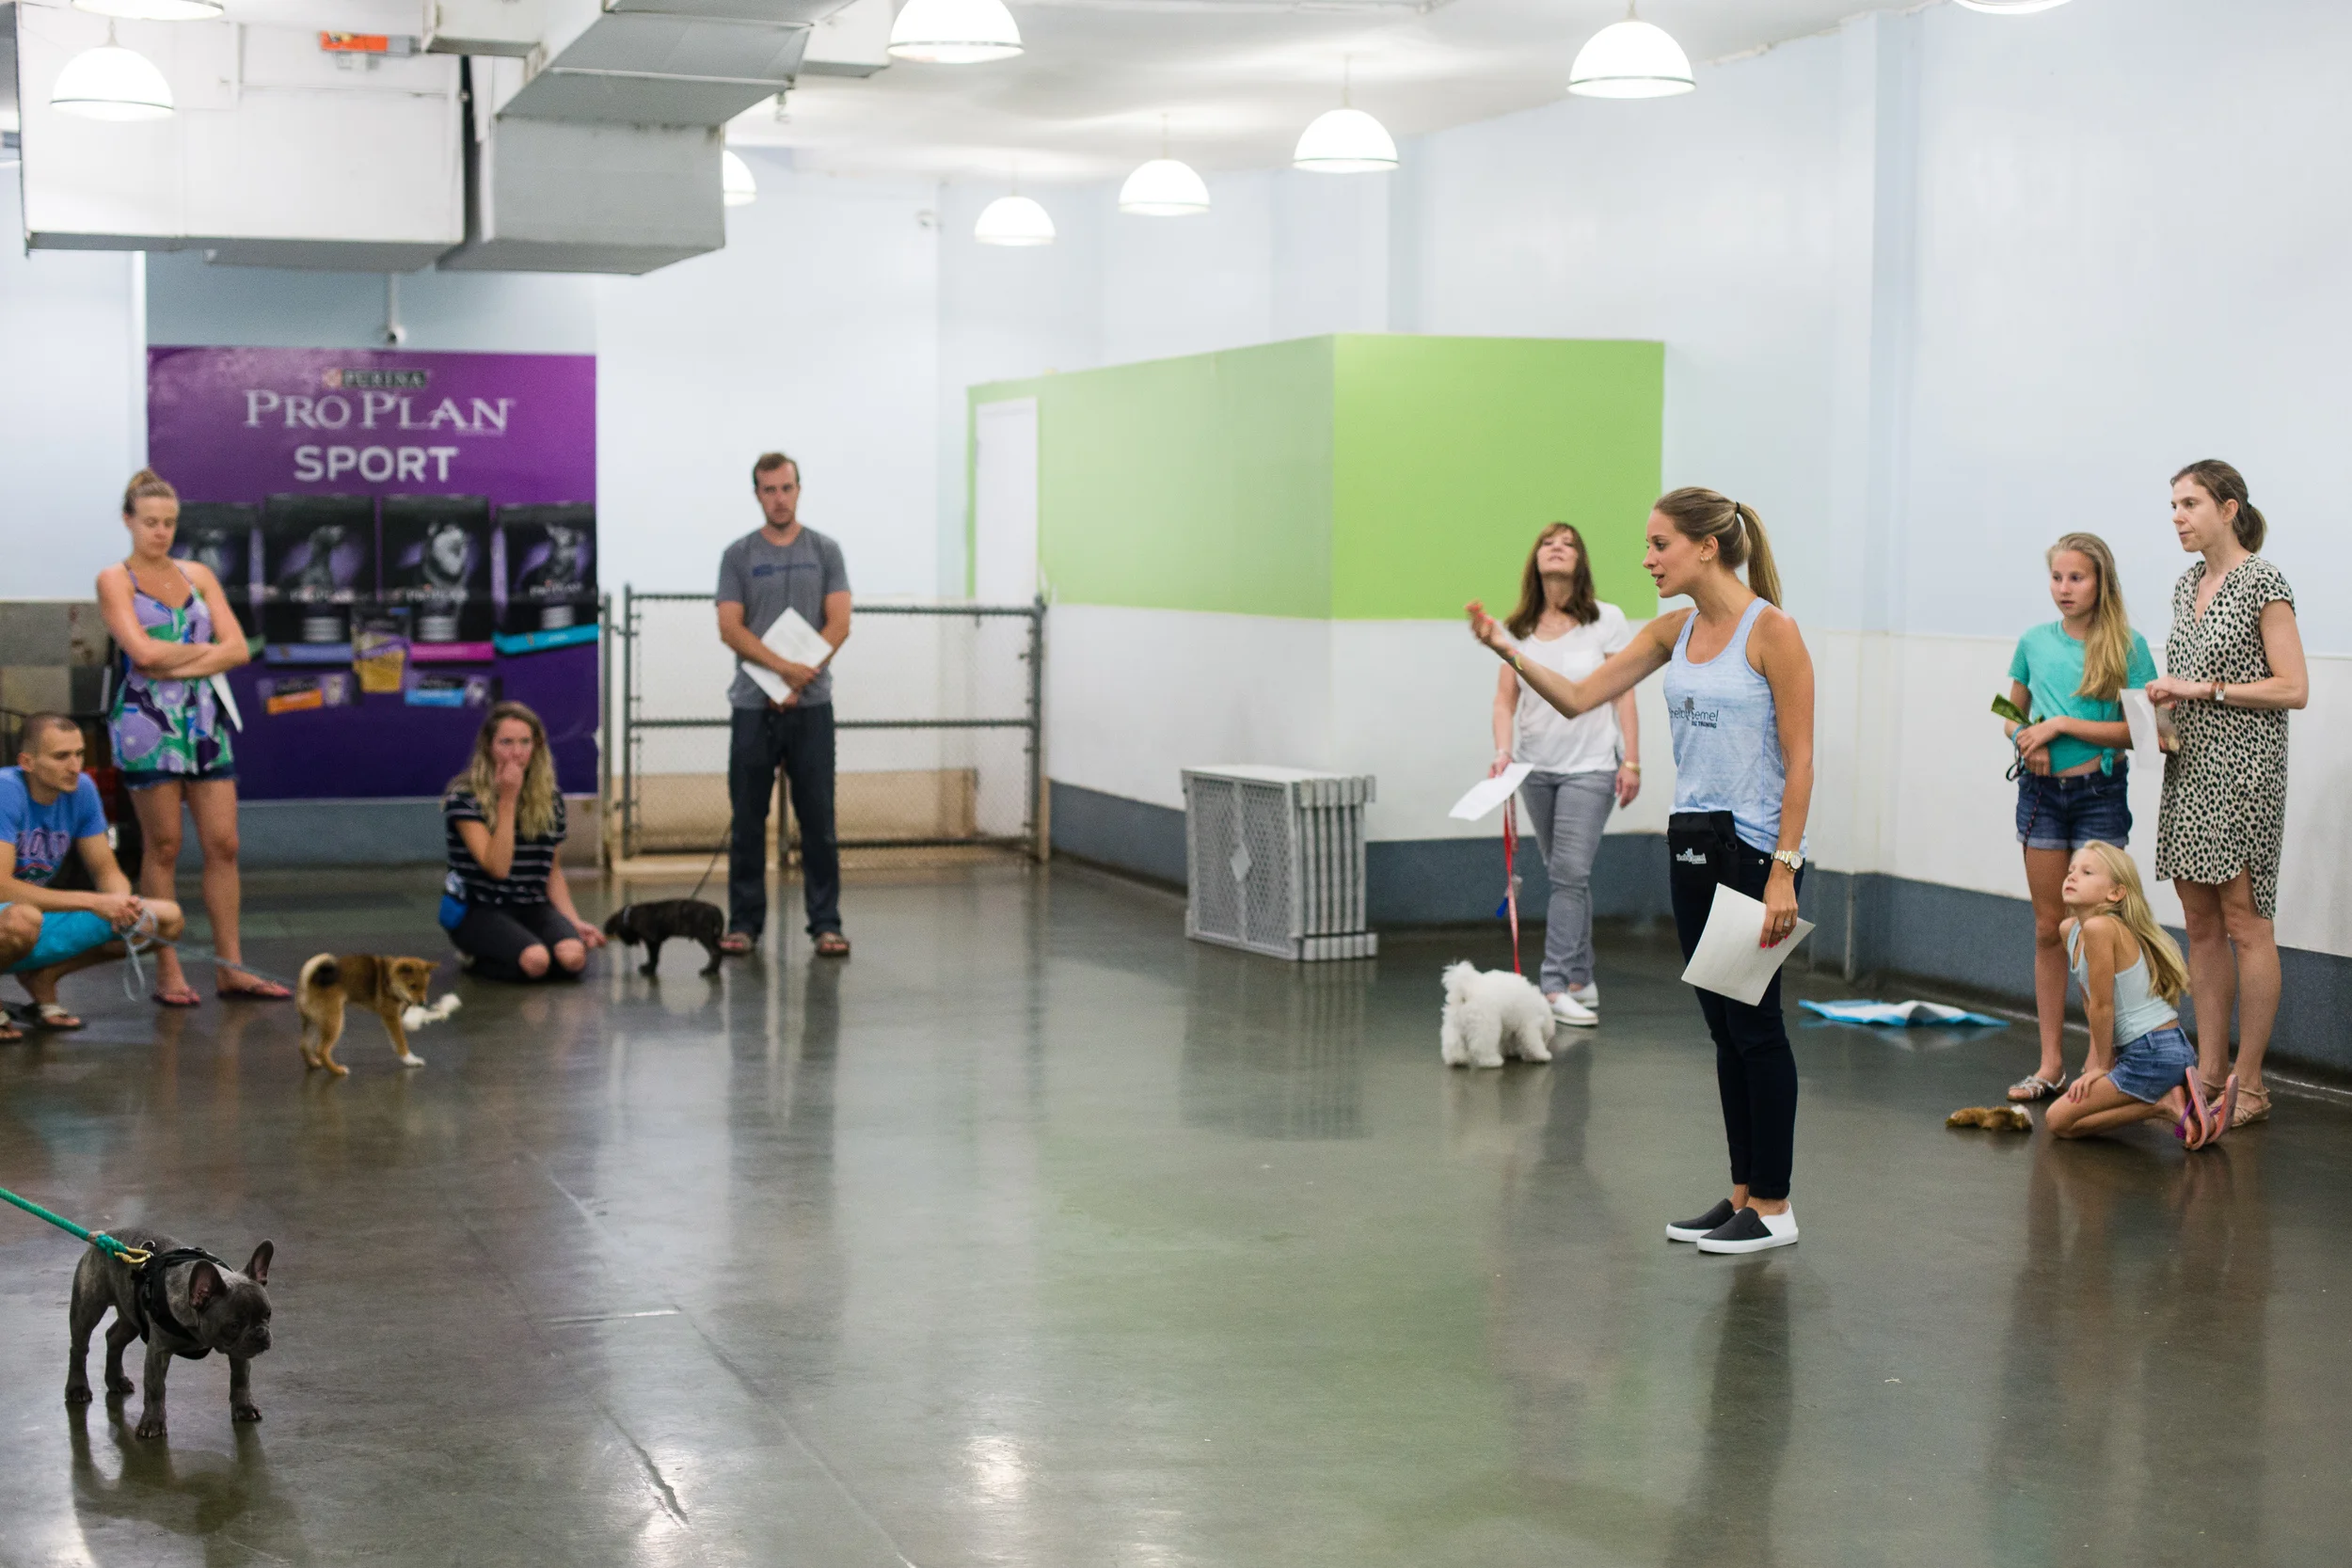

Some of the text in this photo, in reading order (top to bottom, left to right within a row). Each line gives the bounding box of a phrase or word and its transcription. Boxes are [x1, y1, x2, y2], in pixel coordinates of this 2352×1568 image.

[246, 389, 509, 429] PRO PLAN
[294, 445, 459, 482] SPORT
